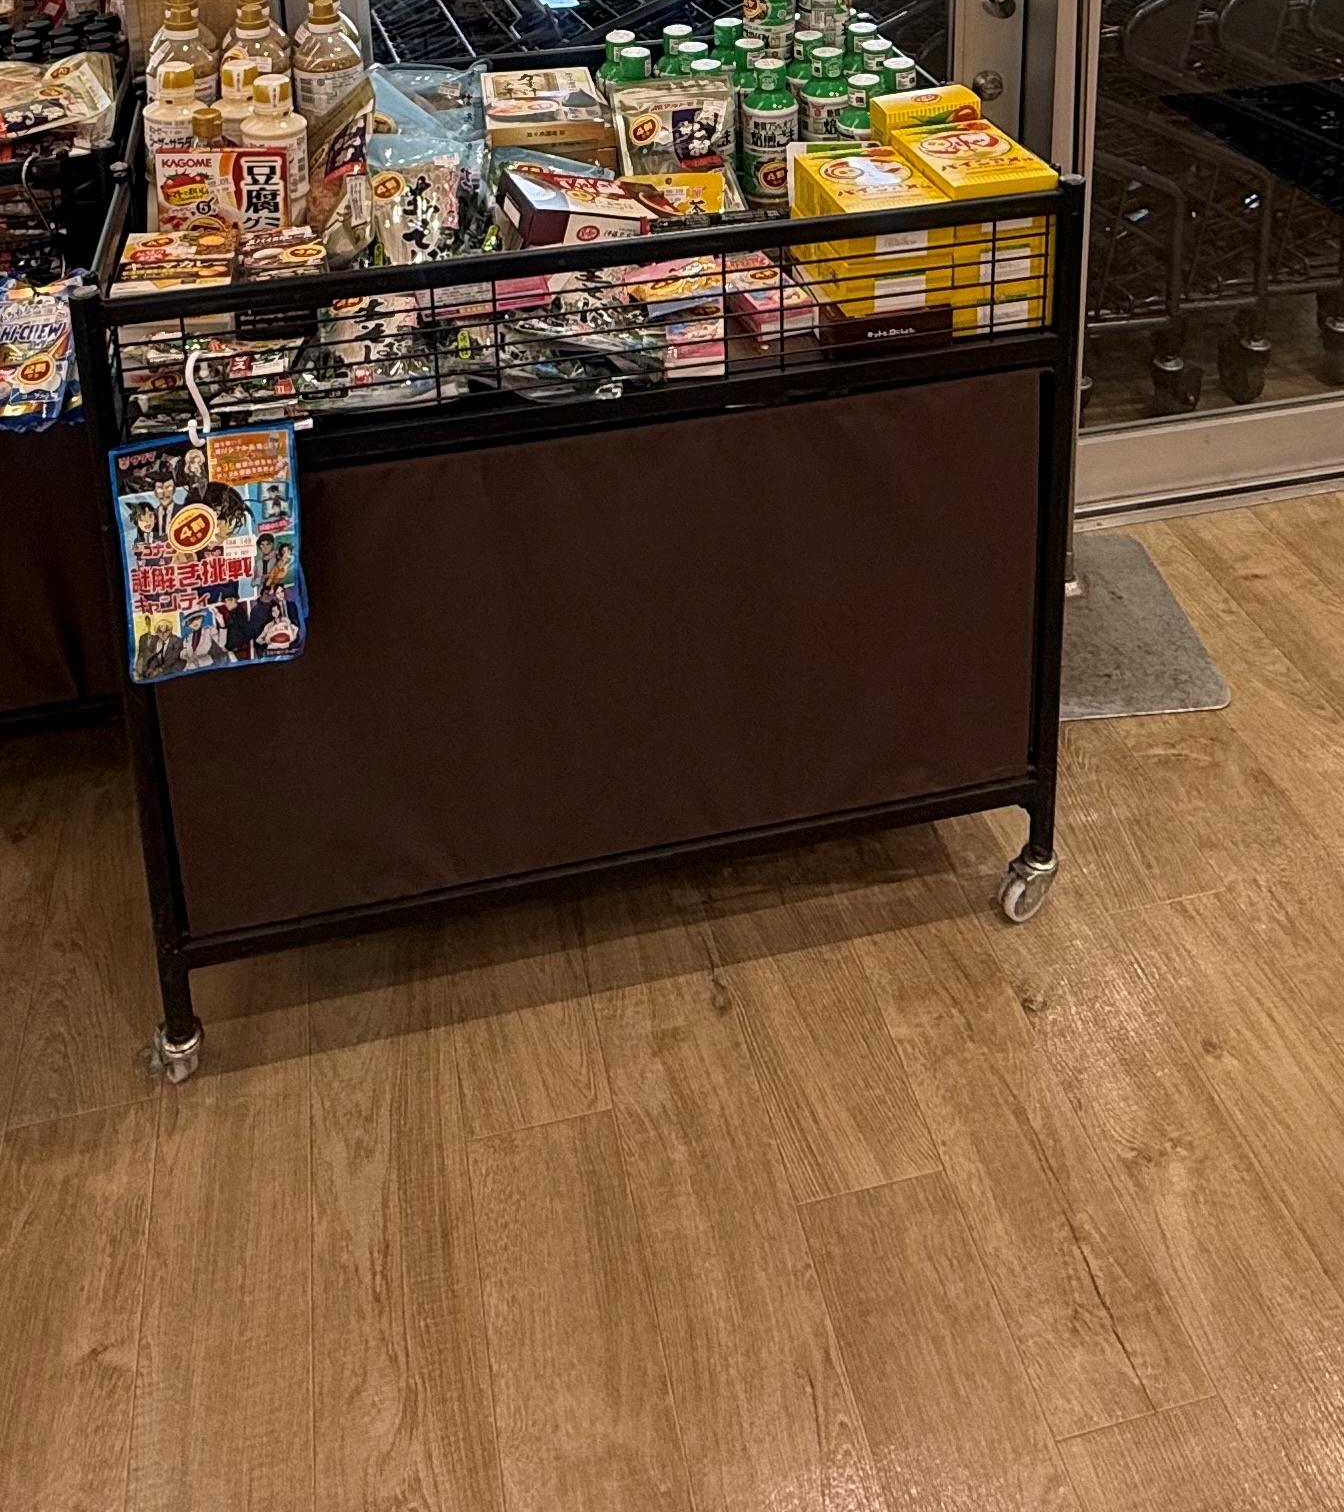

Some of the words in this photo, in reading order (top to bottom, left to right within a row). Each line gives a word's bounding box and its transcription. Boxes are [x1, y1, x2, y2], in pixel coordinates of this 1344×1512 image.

[161, 158, 213, 169] KAGOME
[244, 159, 280, 215] 豆腐
[0, 322, 66, 343] HI-CHEW
[179, 517, 207, 541] 4割
[130, 557, 255, 594] 謎解き挑戦
[134, 591, 212, 615] キャンディ
